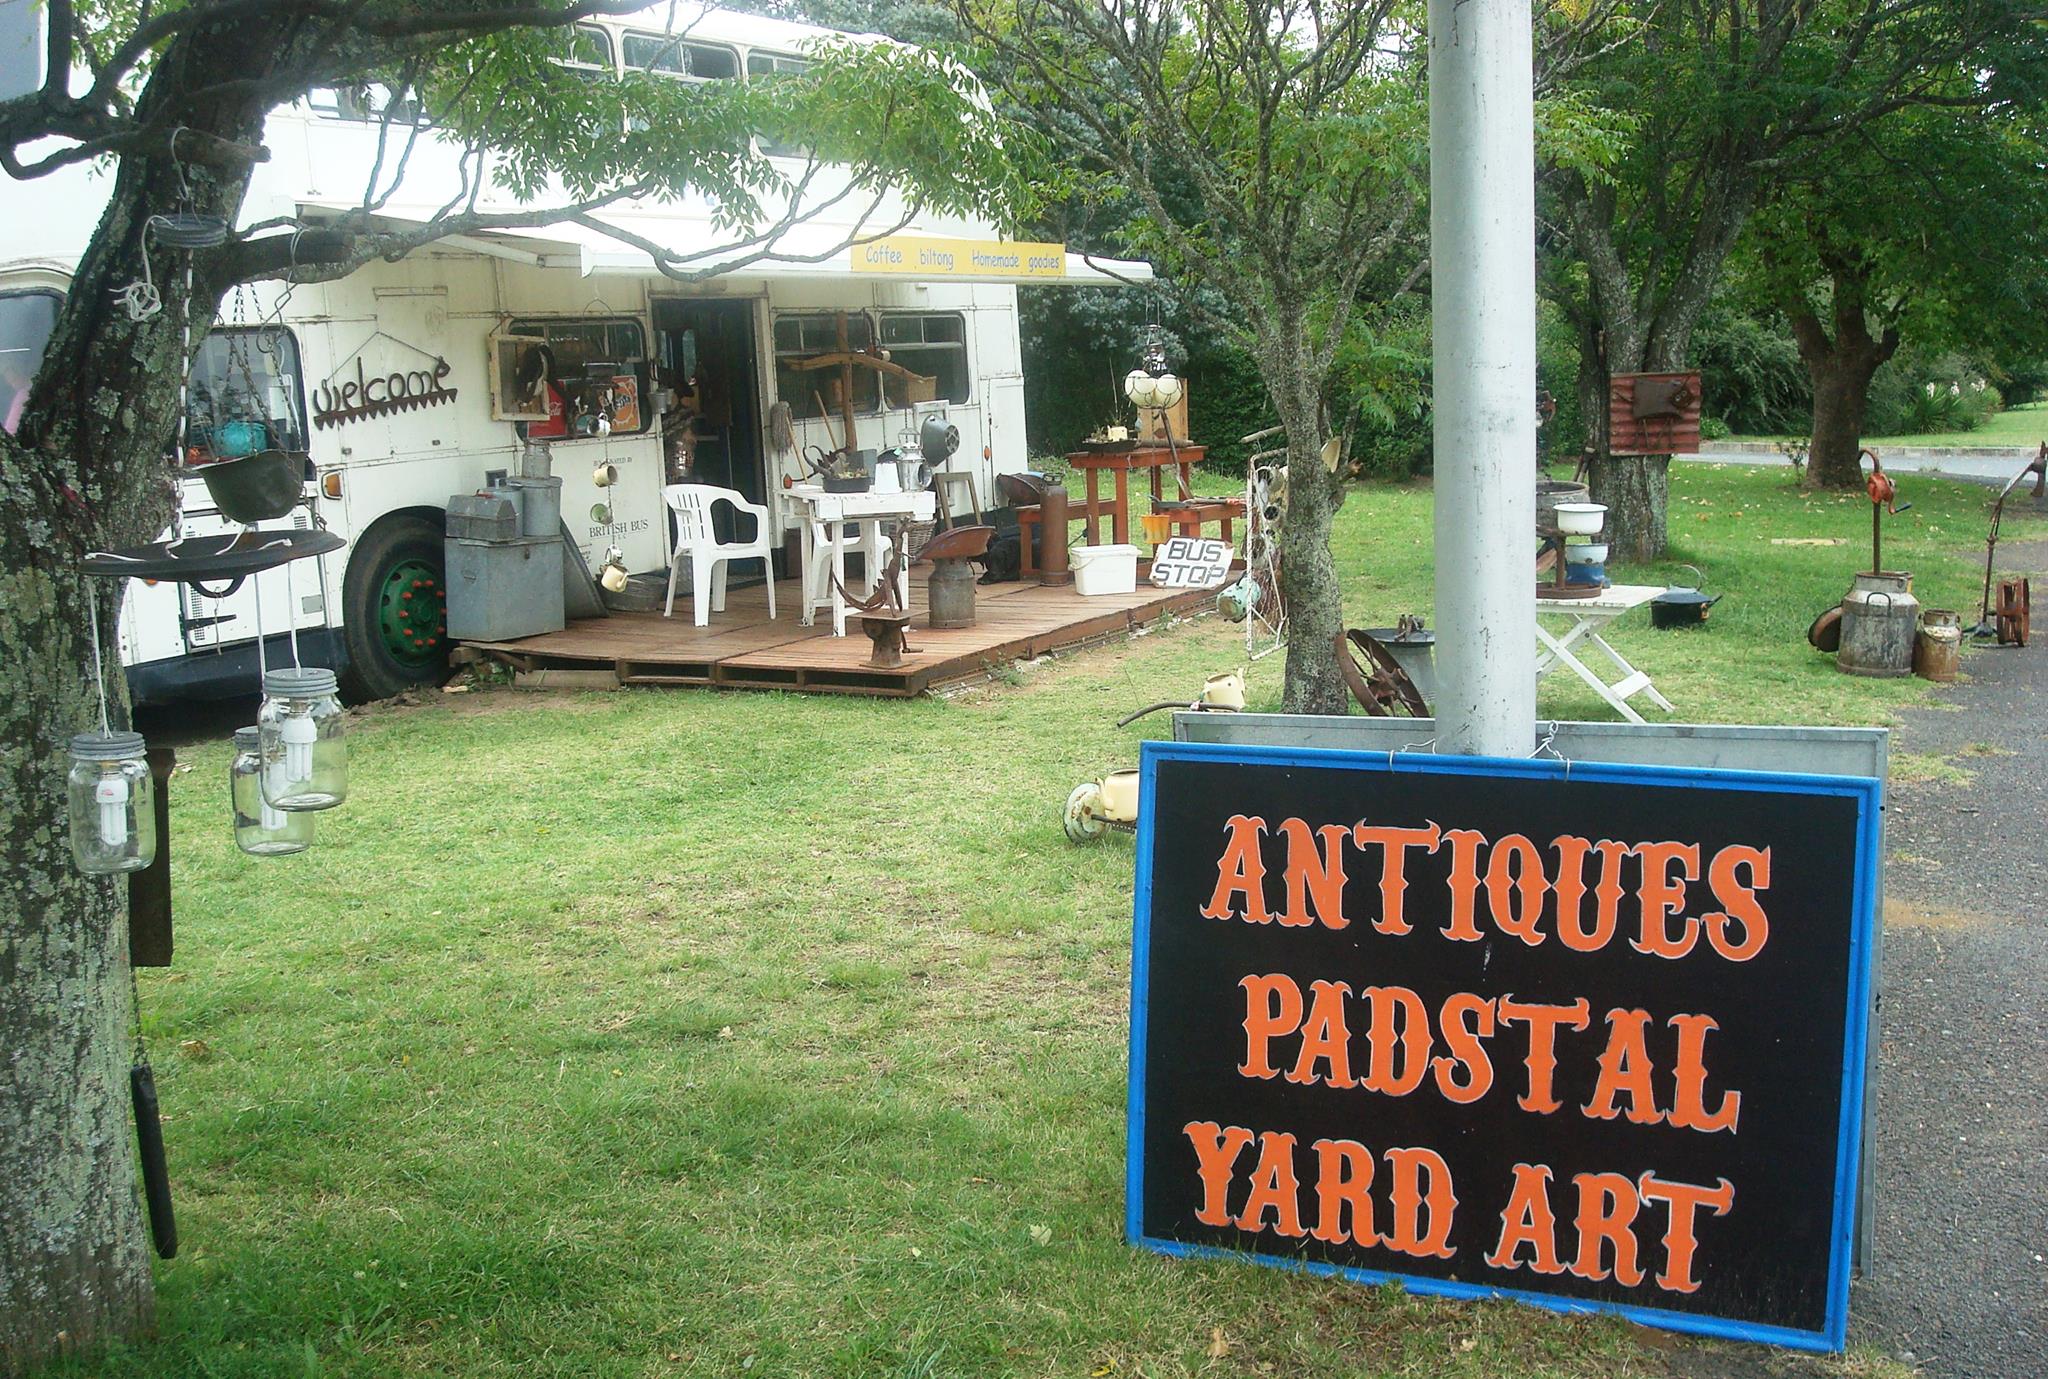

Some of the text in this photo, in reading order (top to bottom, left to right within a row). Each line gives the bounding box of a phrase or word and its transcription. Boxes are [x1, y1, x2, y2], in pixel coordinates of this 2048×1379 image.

[866, 245, 1060, 273] Coffee biltong Homemade goodies
[313, 355, 451, 414] welcome
[589, 522, 628, 538] BRITISH
[631, 519, 649, 532] BUS
[1168, 540, 1223, 562] BUS
[1155, 563, 1226, 585] STOP
[1200, 813, 1772, 961] ANTIQUES
[1237, 974, 1741, 1134] PADSTAL
[1183, 1121, 1735, 1294] YARD ART
